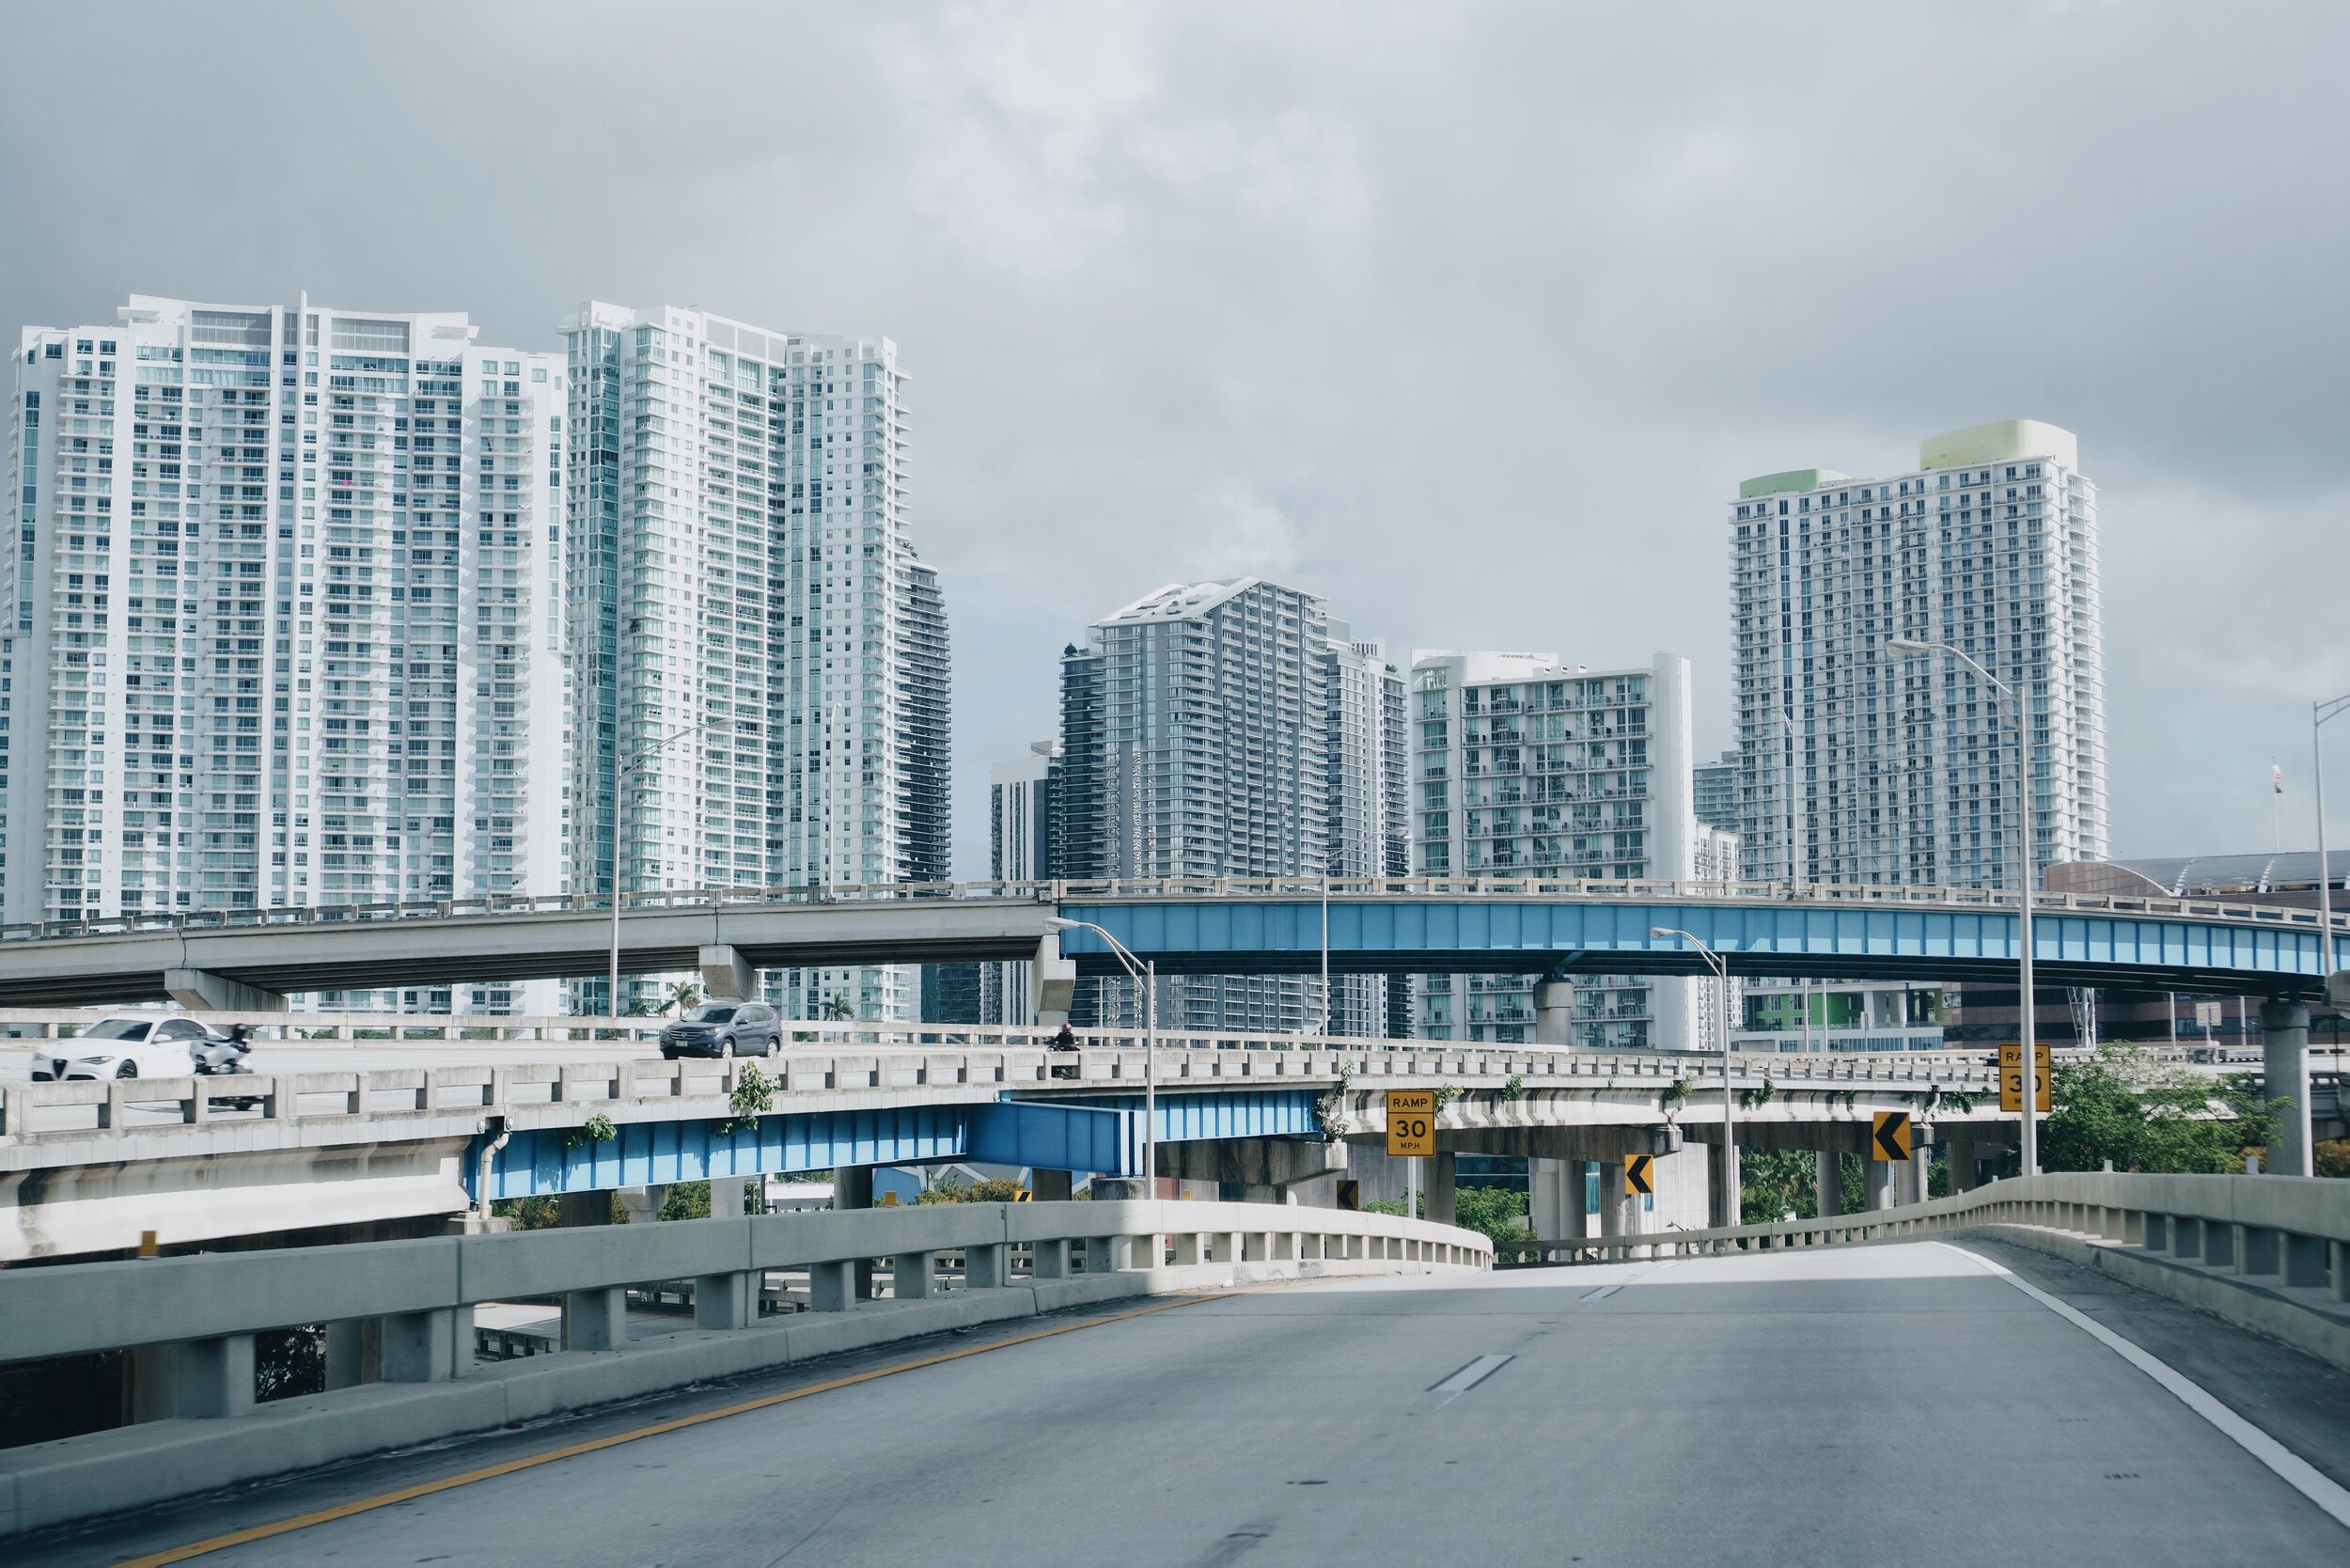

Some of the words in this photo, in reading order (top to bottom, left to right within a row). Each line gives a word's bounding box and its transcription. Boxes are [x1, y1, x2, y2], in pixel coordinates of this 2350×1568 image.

[2006, 1052, 2044, 1061] RAP
[1393, 1098, 1428, 1107] RAMP
[1395, 1120, 1427, 1138] 30
